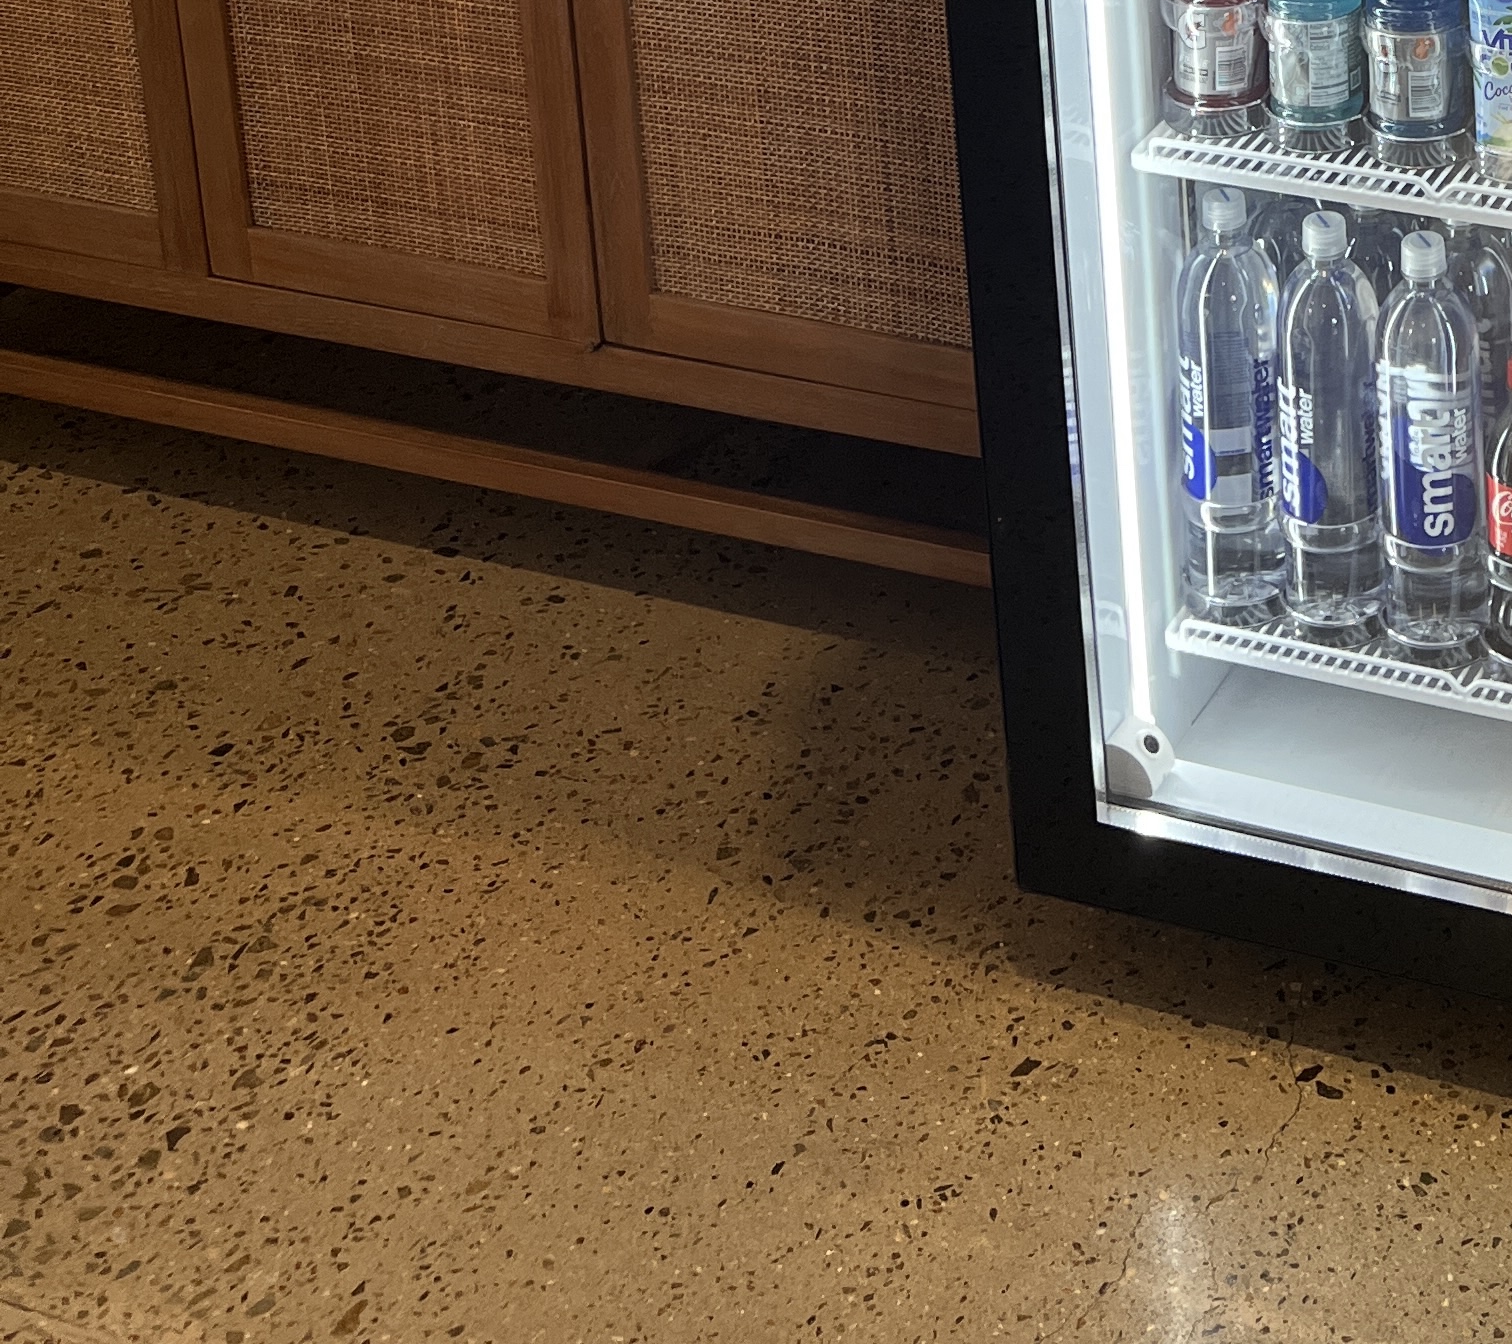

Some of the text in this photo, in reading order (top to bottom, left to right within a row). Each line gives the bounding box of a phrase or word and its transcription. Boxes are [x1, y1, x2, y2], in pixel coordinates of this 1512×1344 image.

[1190, 359, 1204, 418] water
[1297, 387, 1315, 446] water
[1420, 406, 1468, 539] smart water
